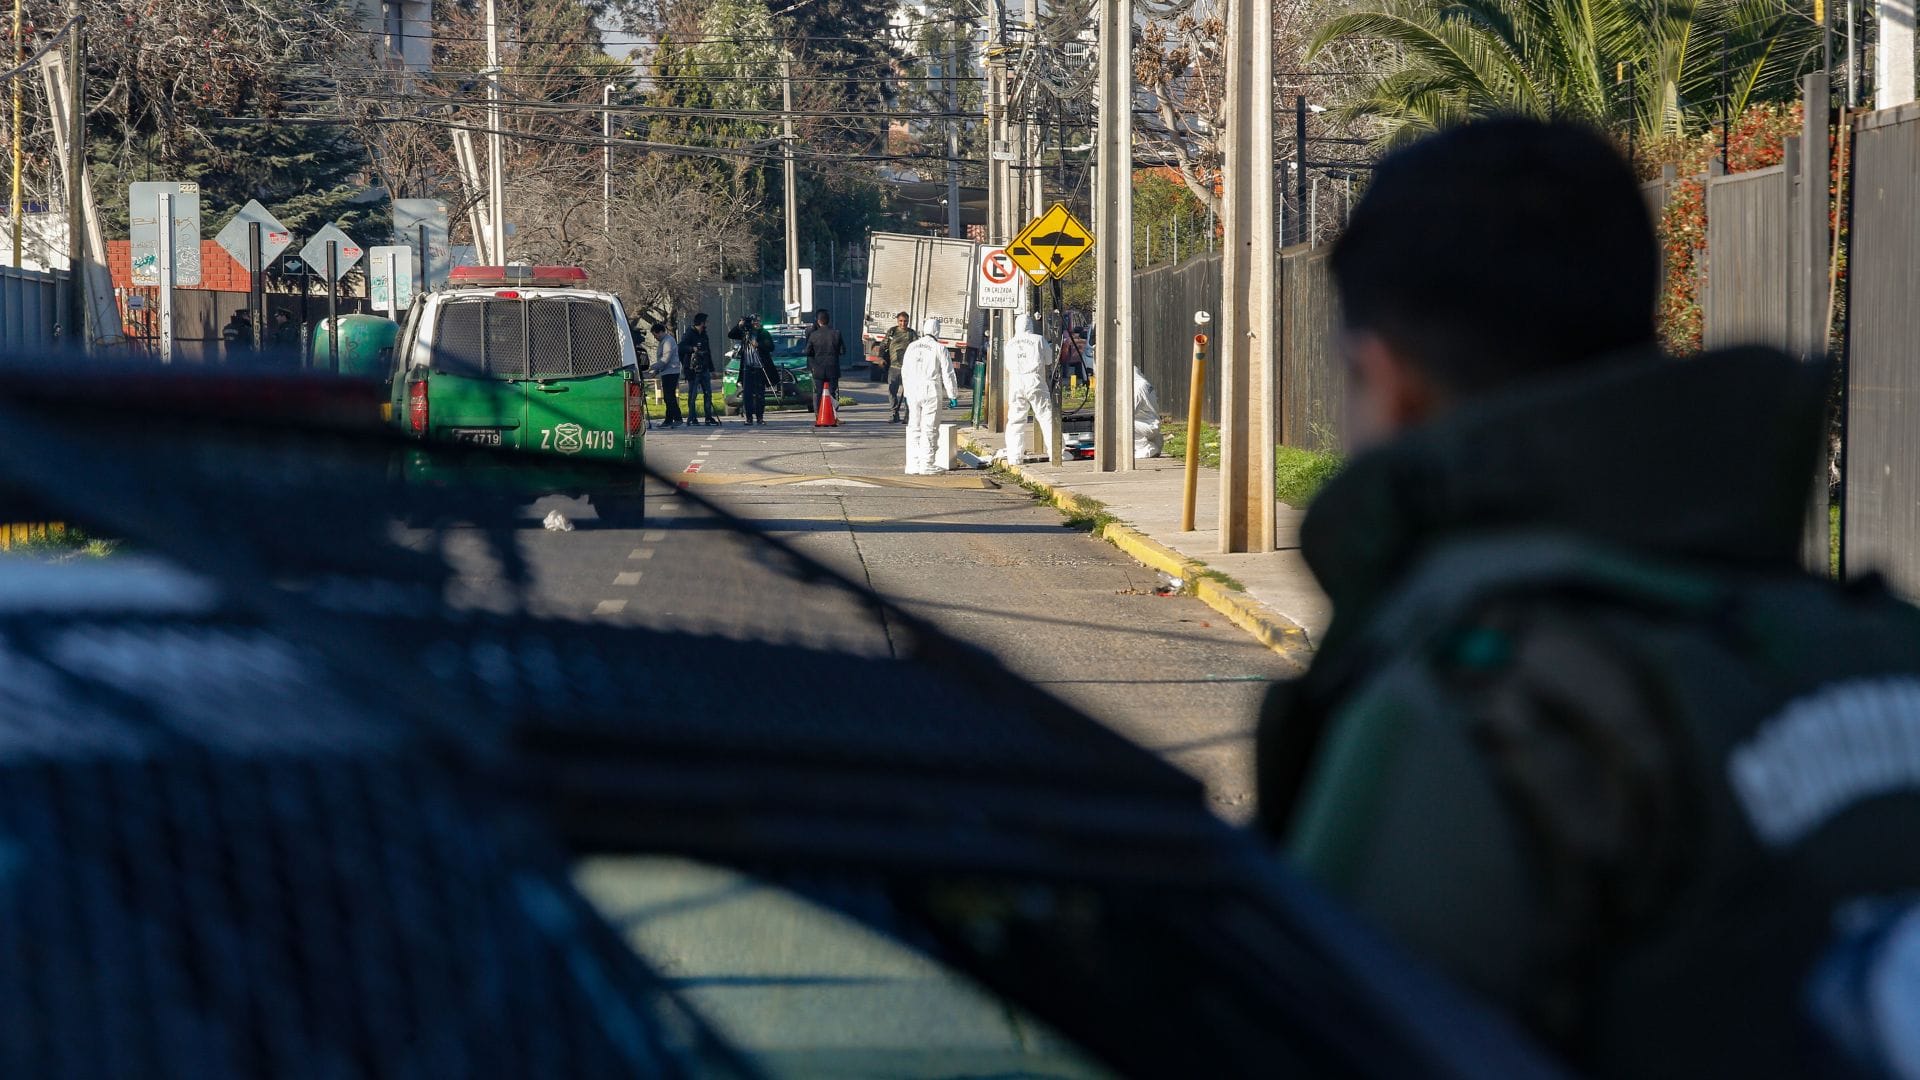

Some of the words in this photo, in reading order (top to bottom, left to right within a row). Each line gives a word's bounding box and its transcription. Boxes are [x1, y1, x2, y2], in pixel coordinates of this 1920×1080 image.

[991, 286, 1012, 294] CALZADA
[541, 429, 550, 449] Z
[585, 430, 614, 450] 4719
